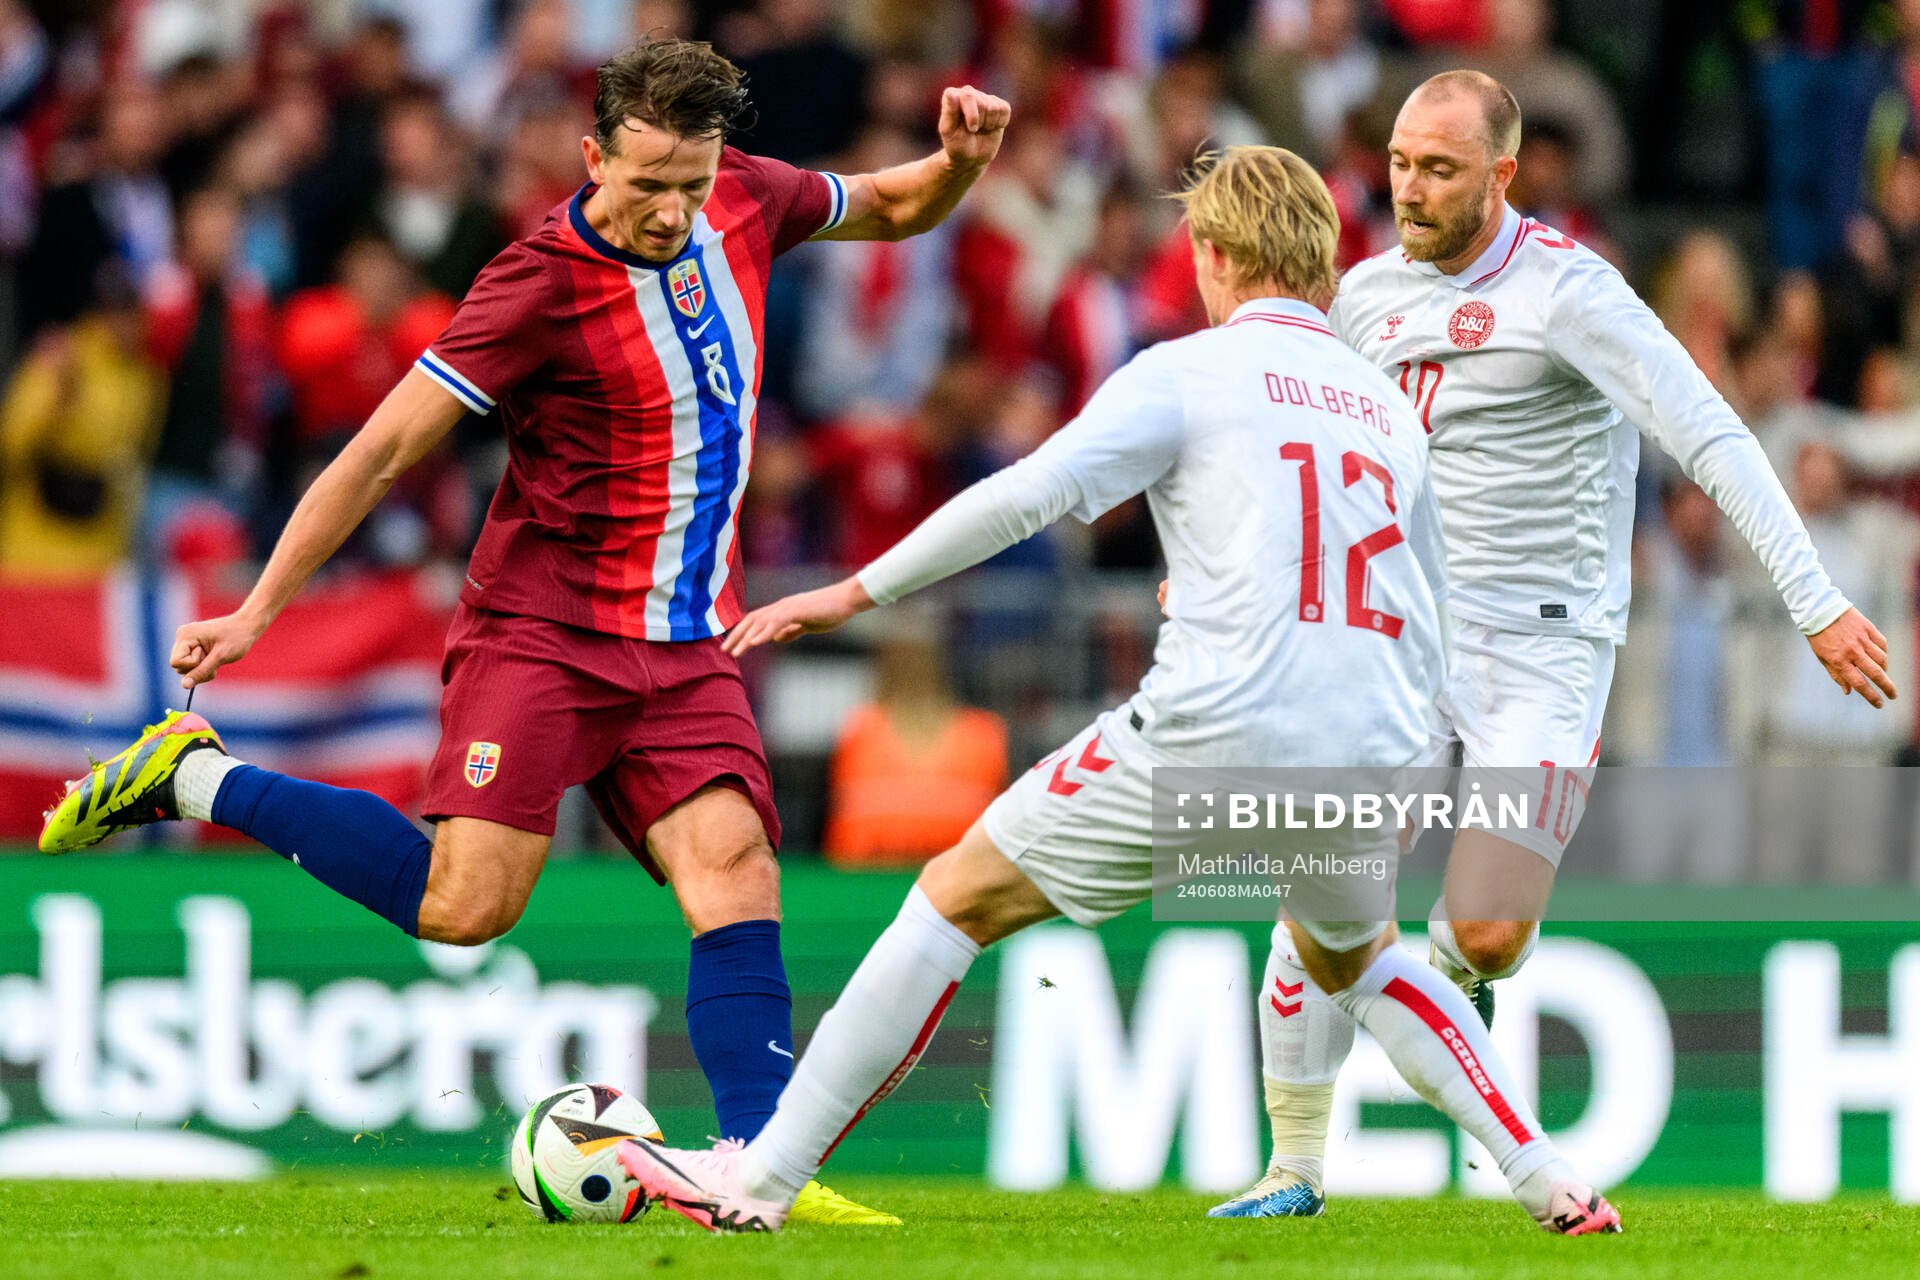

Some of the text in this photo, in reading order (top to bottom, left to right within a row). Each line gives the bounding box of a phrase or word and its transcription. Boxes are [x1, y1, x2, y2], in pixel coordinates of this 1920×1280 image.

[1457, 316, 1487, 332] DBU
[701, 341, 736, 405] 8
[1264, 372, 1391, 436] DOLBERG
[1397, 360, 1444, 434] 10
[1279, 442, 1405, 640] 12
[1534, 760, 1579, 846] 10
